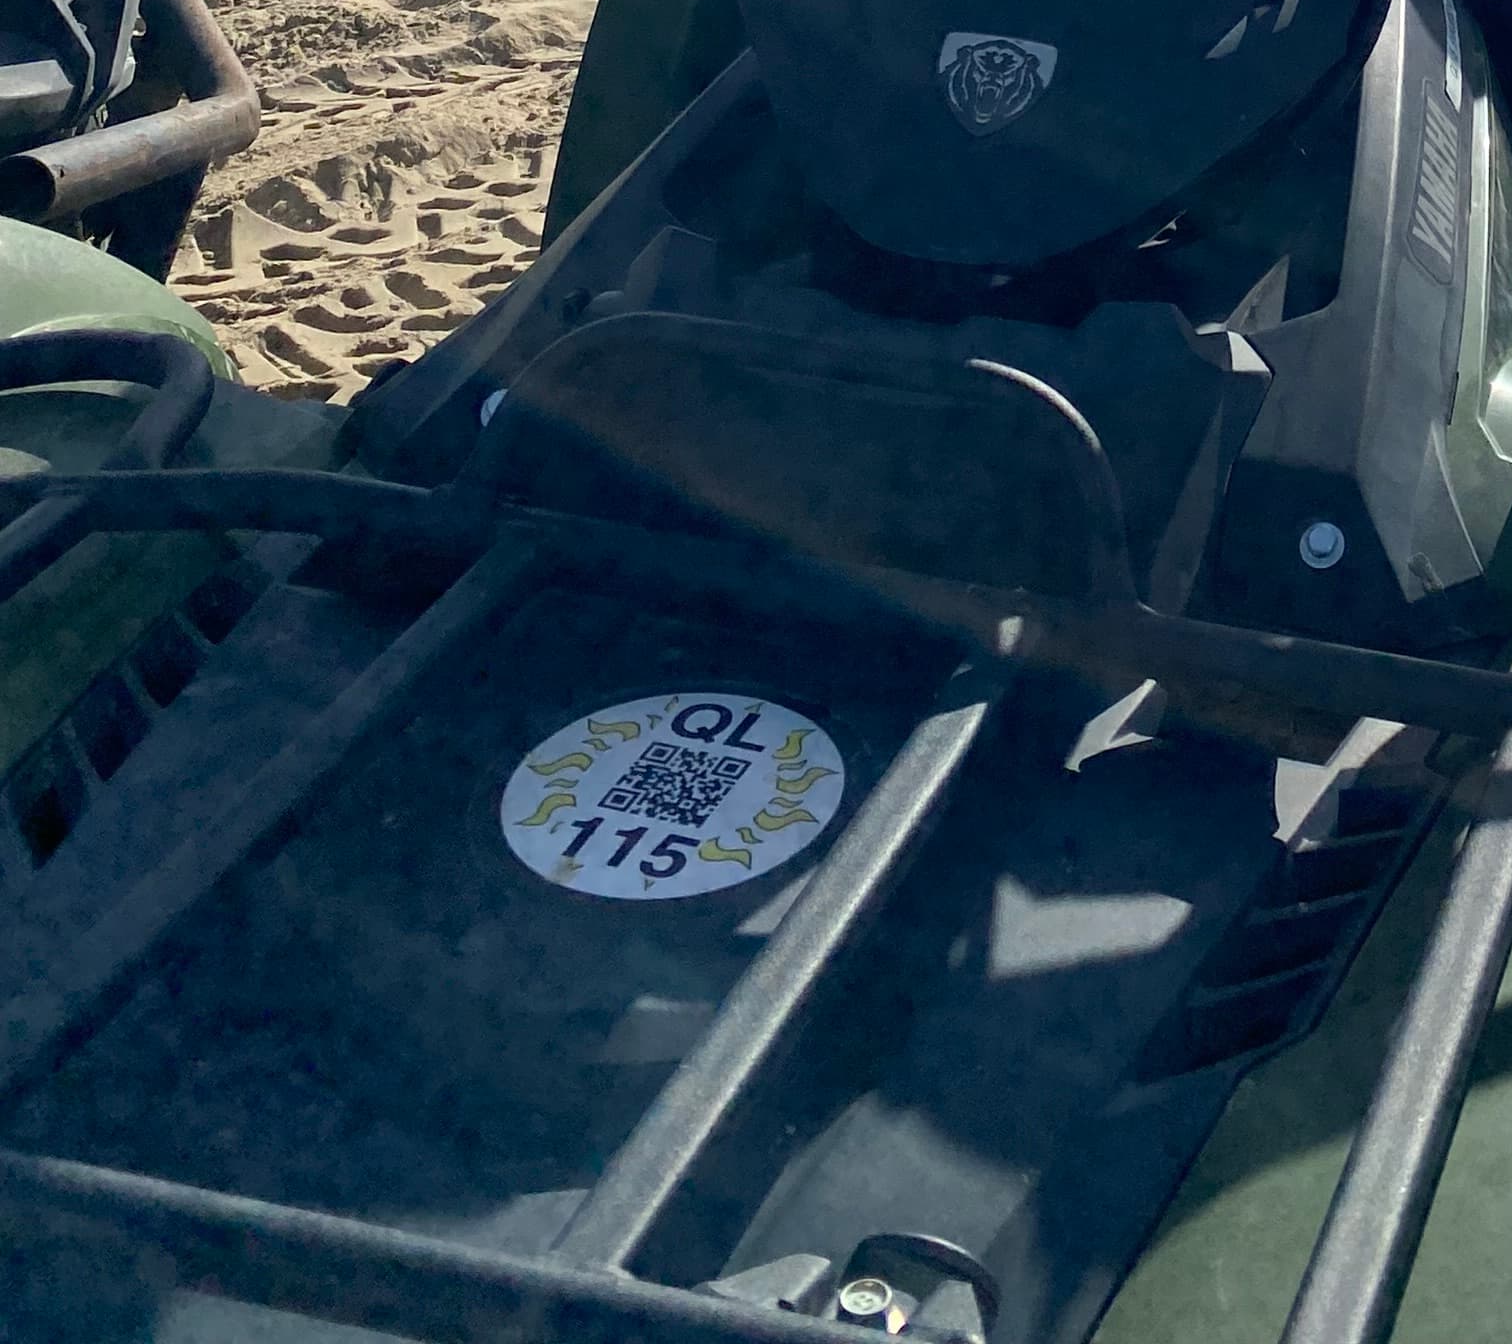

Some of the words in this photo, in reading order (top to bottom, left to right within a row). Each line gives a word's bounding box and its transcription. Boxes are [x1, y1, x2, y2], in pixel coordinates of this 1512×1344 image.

[1413, 95, 1458, 264] YAMAHA
[671, 703, 766, 753] QL
[562, 817, 700, 879] 115
